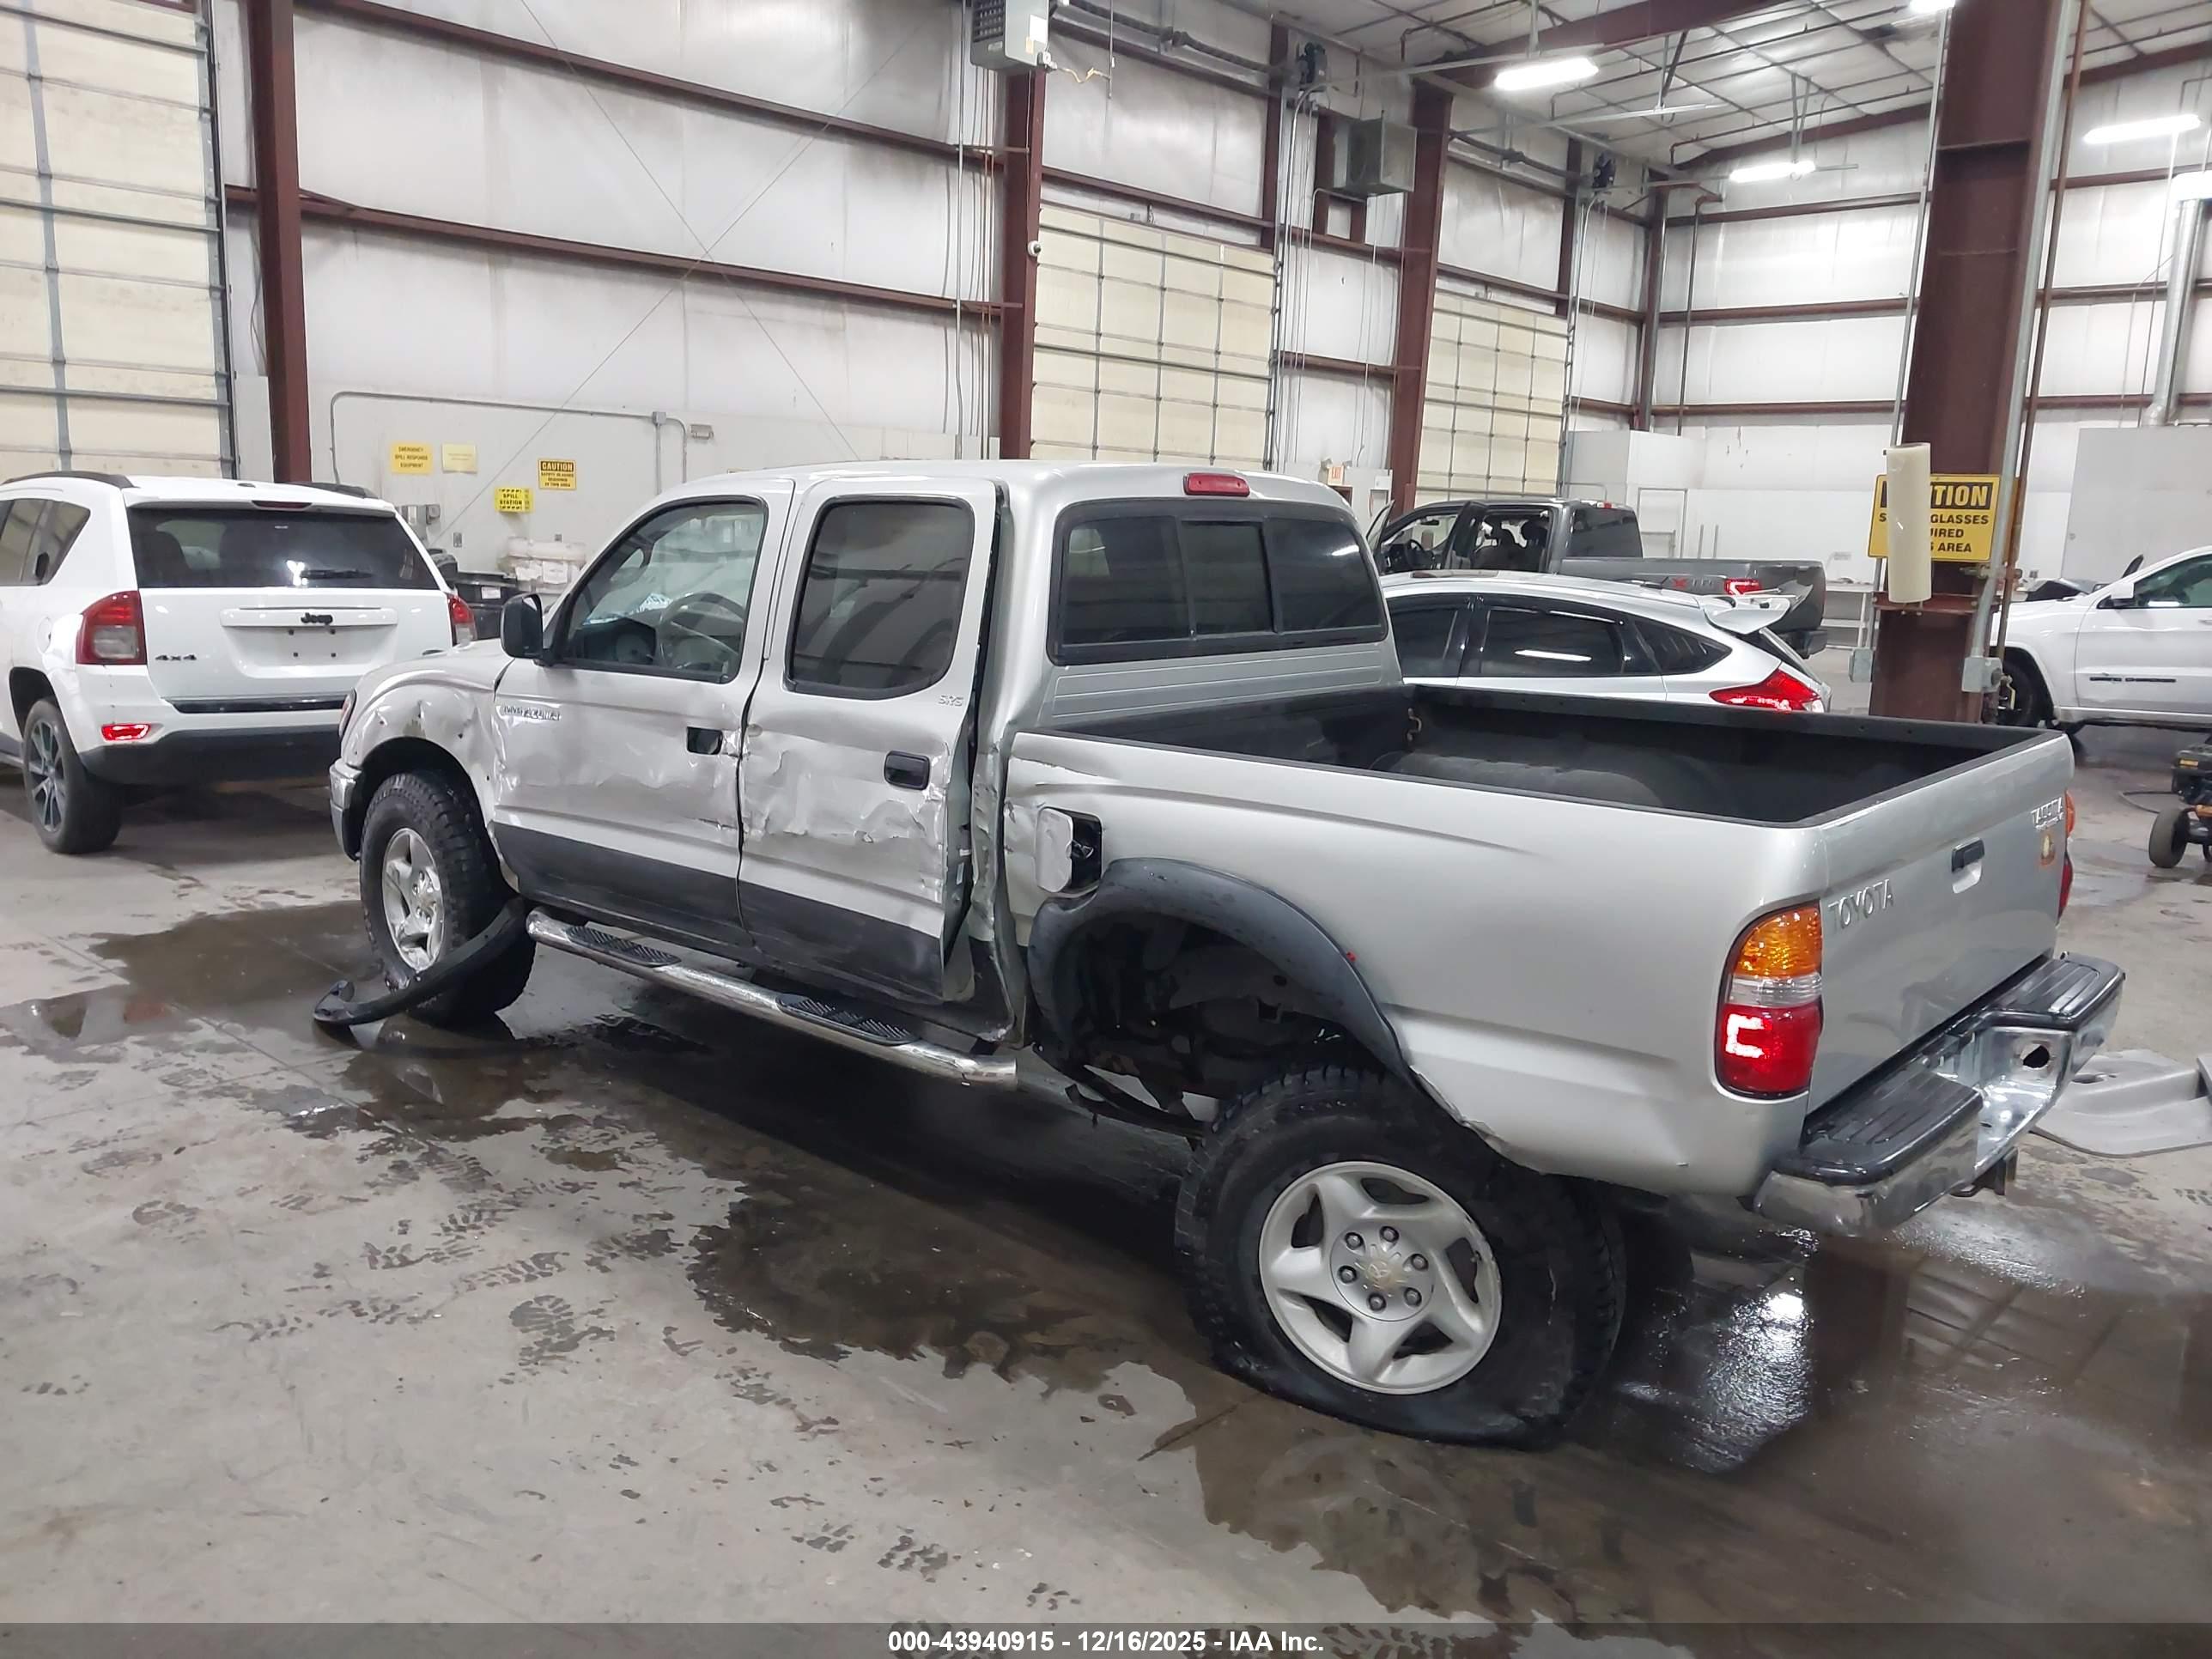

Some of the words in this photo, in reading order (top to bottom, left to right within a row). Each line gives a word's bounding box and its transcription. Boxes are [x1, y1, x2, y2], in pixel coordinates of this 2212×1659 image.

[542, 461, 573, 471] CAUTION
[1930, 484, 1988, 507] TION
[1930, 514, 1989, 525] GLASSES
[1937, 542, 1972, 553] AREA
[301, 612, 333, 625] Jeep
[1827, 878, 1894, 932] TOYOTA
